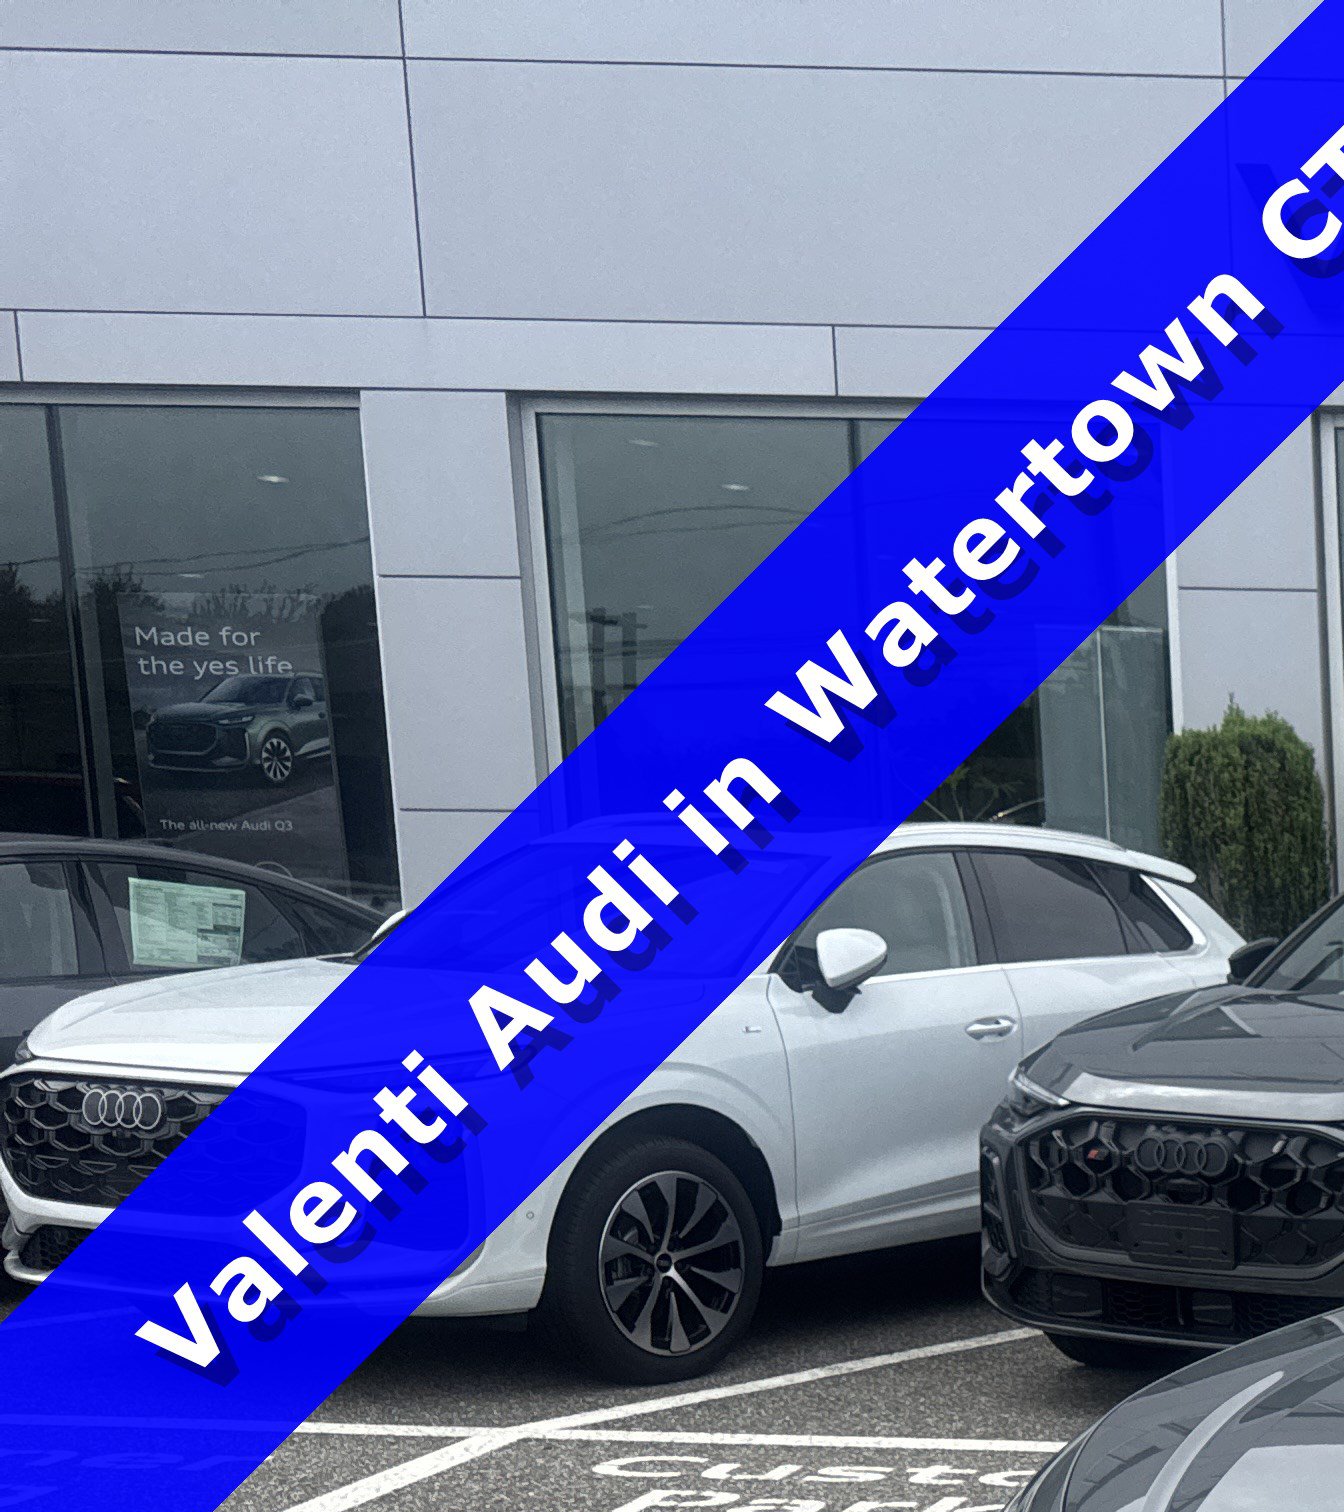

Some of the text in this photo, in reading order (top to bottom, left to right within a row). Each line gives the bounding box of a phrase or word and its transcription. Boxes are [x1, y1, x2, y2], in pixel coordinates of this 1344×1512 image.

[134, 626, 260, 646] Made for
[138, 655, 293, 680] the yes life
[160, 819, 293, 831] The all-new Audi Q3
